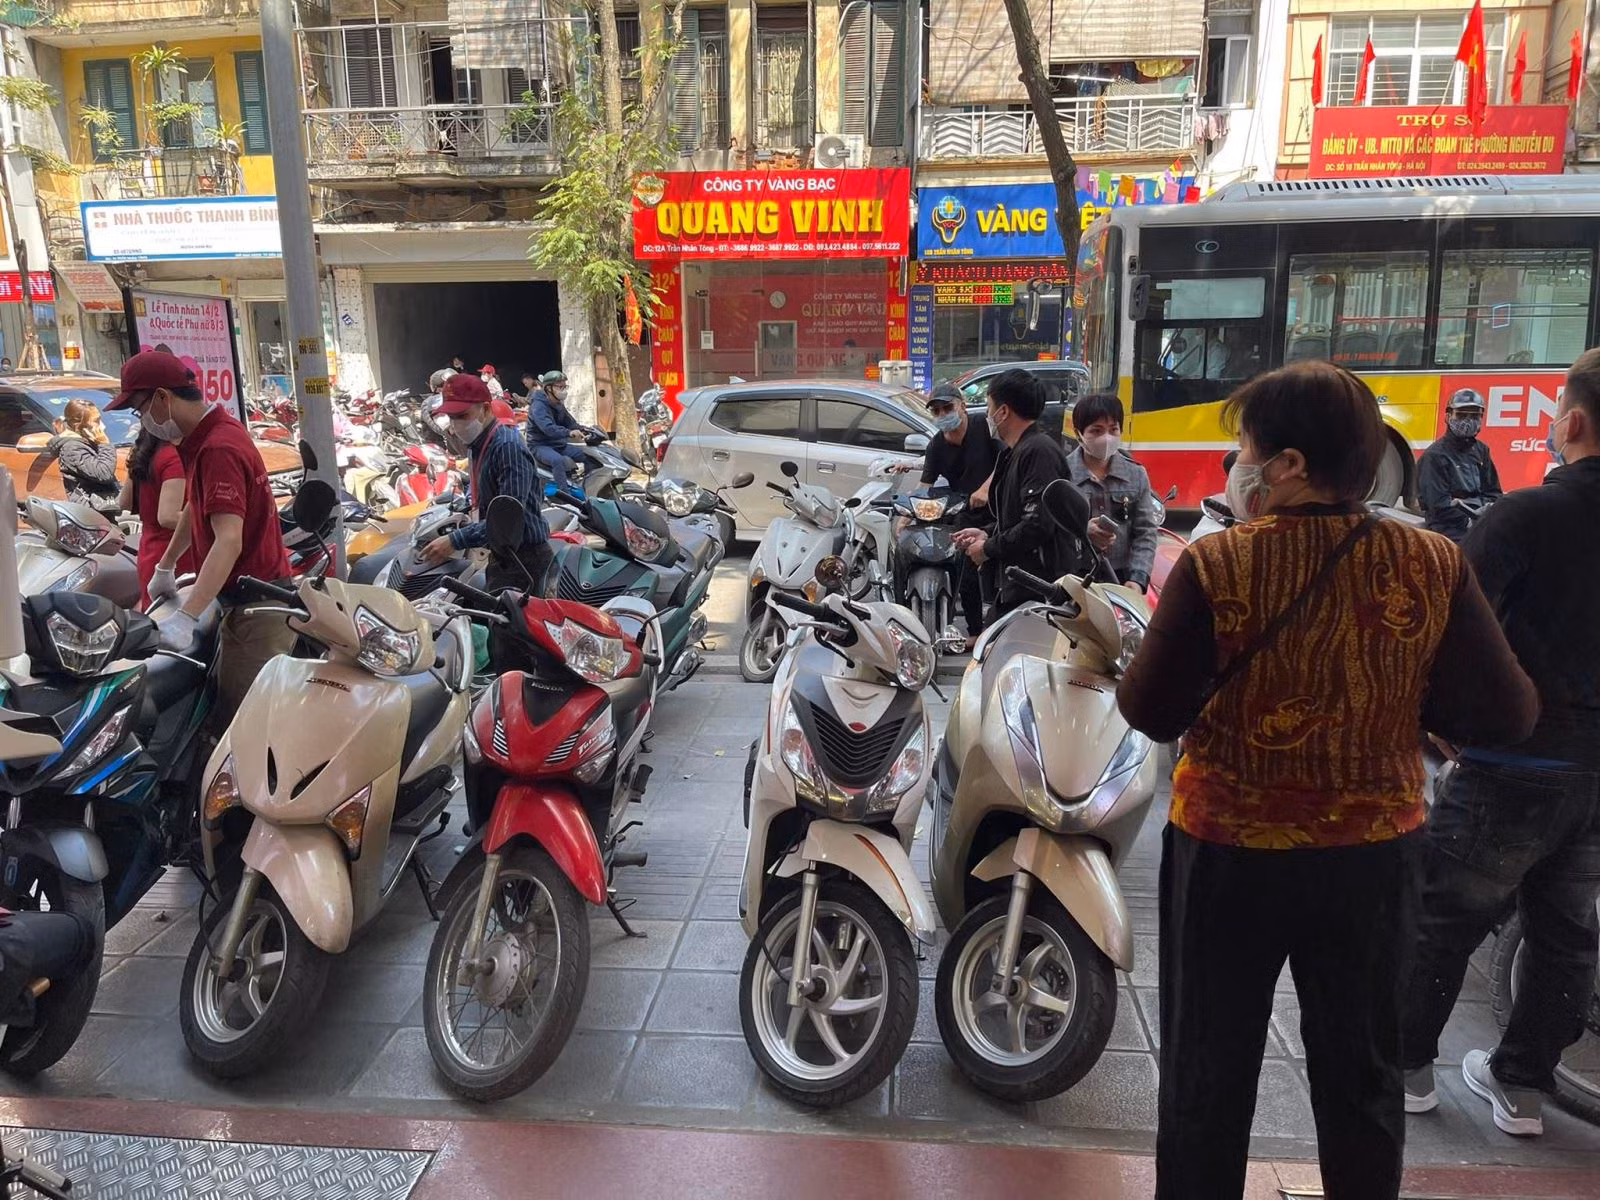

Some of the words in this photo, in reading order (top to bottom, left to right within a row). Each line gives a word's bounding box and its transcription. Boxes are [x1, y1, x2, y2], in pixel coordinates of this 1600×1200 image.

[1396, 114, 1447, 128] TRỤ
[1417, 133, 1433, 154] CÁC
[703, 176, 742, 192] CÔNG
[745, 179, 763, 191] TY
[767, 175, 804, 191] VÀNG
[808, 178, 836, 193] BẠC
[113, 209, 143, 226] NHÀ
[148, 206, 193, 225] THUỐC
[199, 209, 244, 224] THANH
[657, 201, 779, 238] QUANG
[790, 199, 884, 237] VINH
[976, 203, 1048, 233] VÀNG
[201, 305, 220, 317] 14/2
[185, 318, 200, 332] Phụ
[210, 320, 224, 331] 8/3
[531, 681, 564, 692] HONDA
